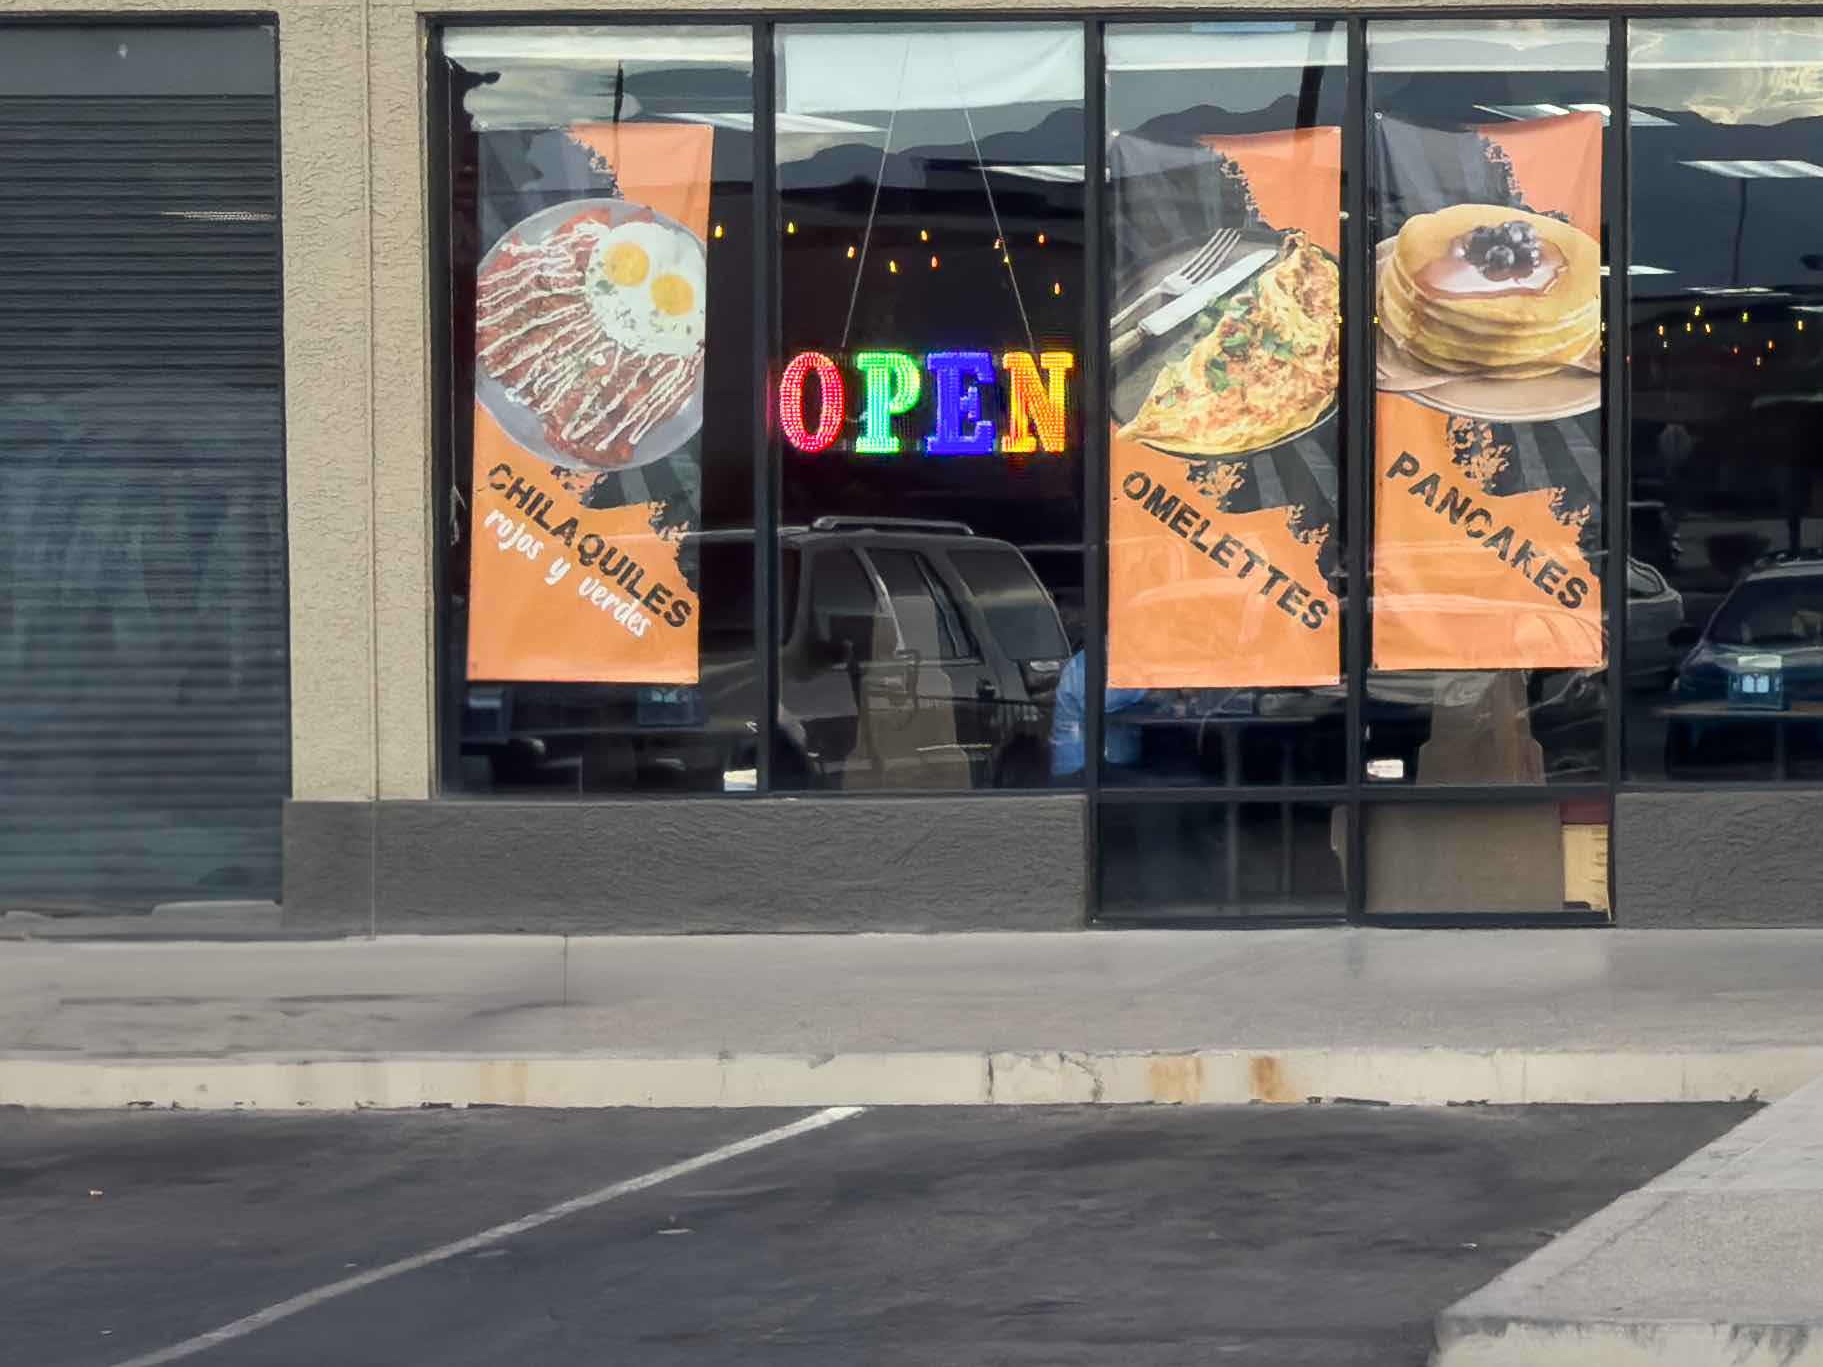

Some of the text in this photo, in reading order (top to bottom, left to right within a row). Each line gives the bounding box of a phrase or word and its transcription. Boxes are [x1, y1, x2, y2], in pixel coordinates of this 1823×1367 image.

[779, 350, 1075, 454] OPEN
[484, 509, 653, 637] rojos y verdes
[487, 463, 693, 628] CHILAQUILES
[1121, 470, 1331, 630] OMELETTES
[1386, 450, 1589, 609] PANCAKES
